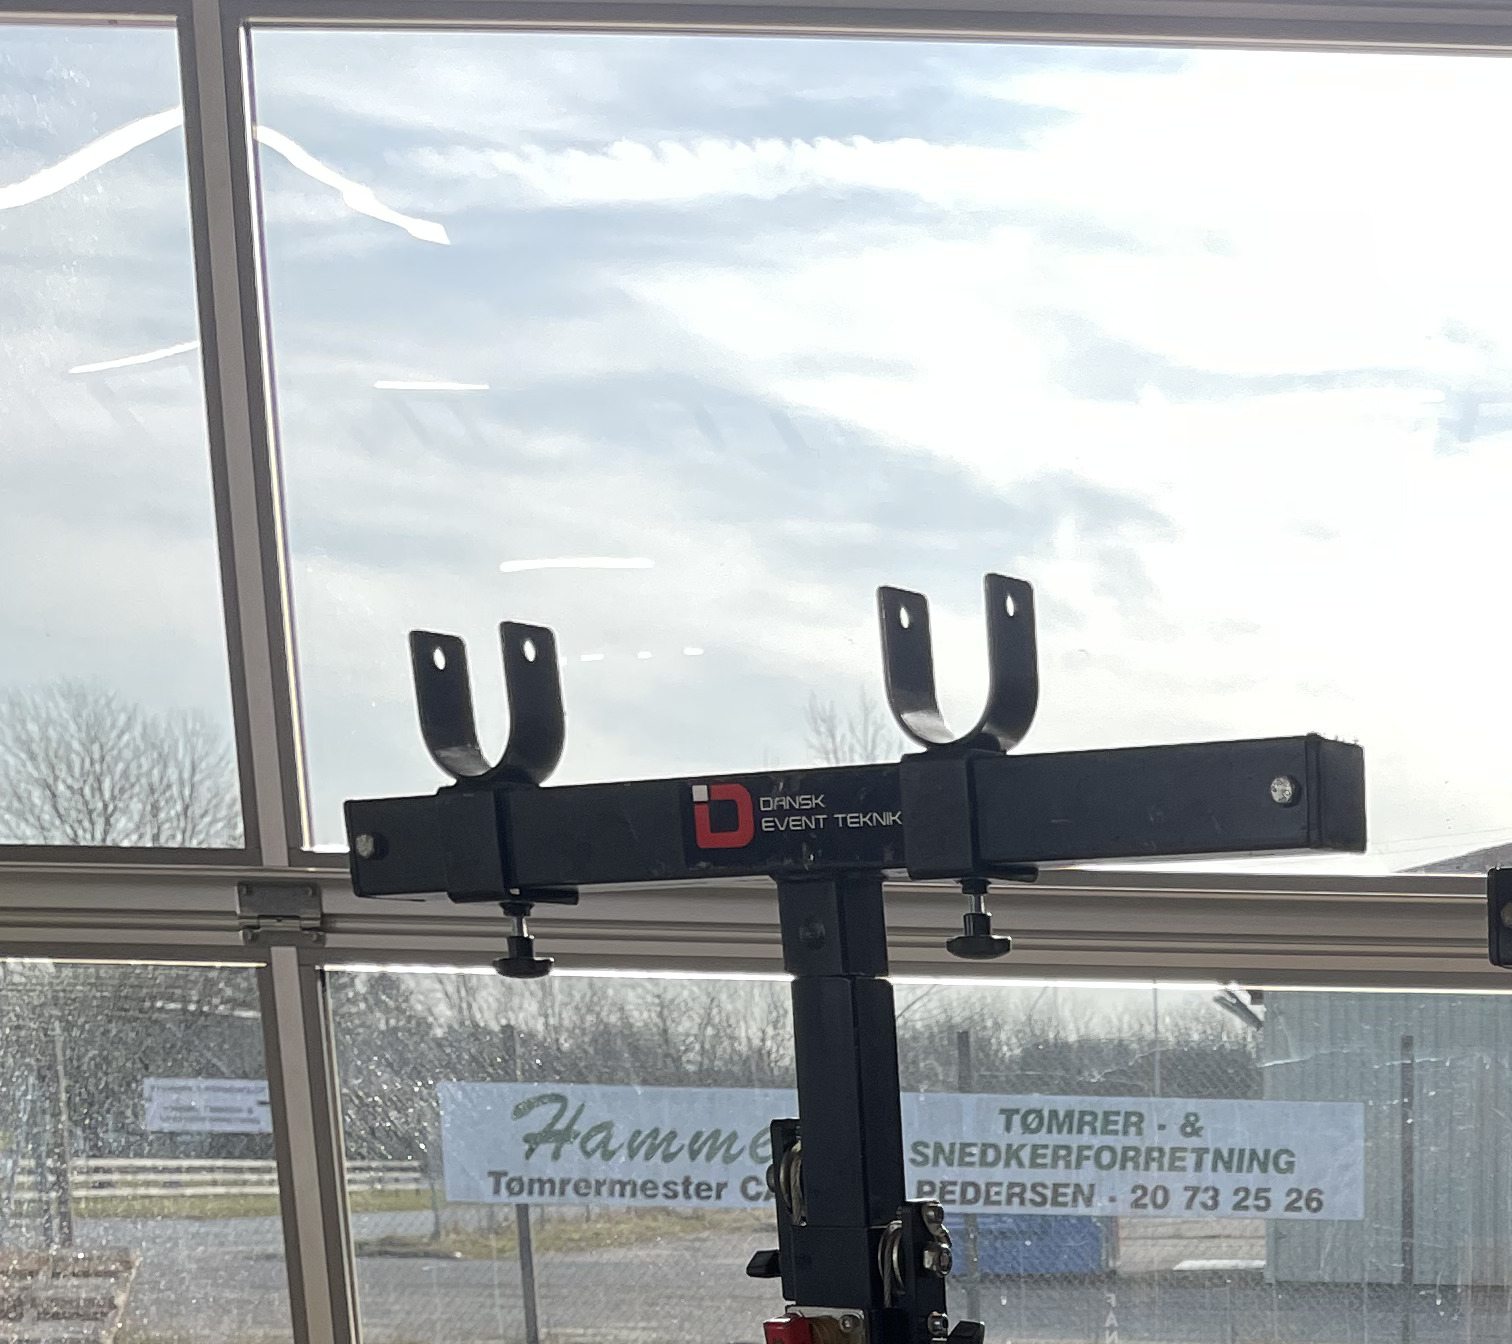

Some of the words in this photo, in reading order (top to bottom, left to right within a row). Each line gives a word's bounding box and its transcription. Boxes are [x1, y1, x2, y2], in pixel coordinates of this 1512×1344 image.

[760, 794, 826, 811] DANSK
[762, 814, 828, 831] EVENT
[833, 811, 902, 828] TEKNIK
[999, 1108, 1145, 1136] TØMRER
[1179, 1112, 1204, 1138] &
[908, 1141, 1297, 1174] SNEDKERFORRETNING
[487, 1169, 728, 1201] Tømrermester
[916, 1180, 1097, 1208] PEDERSEN
[1130, 1185, 1169, 1210] 20
[1183, 1186, 1220, 1211] 73
[1232, 1187, 1272, 1212] 25
[1284, 1188, 1324, 1214] 26
